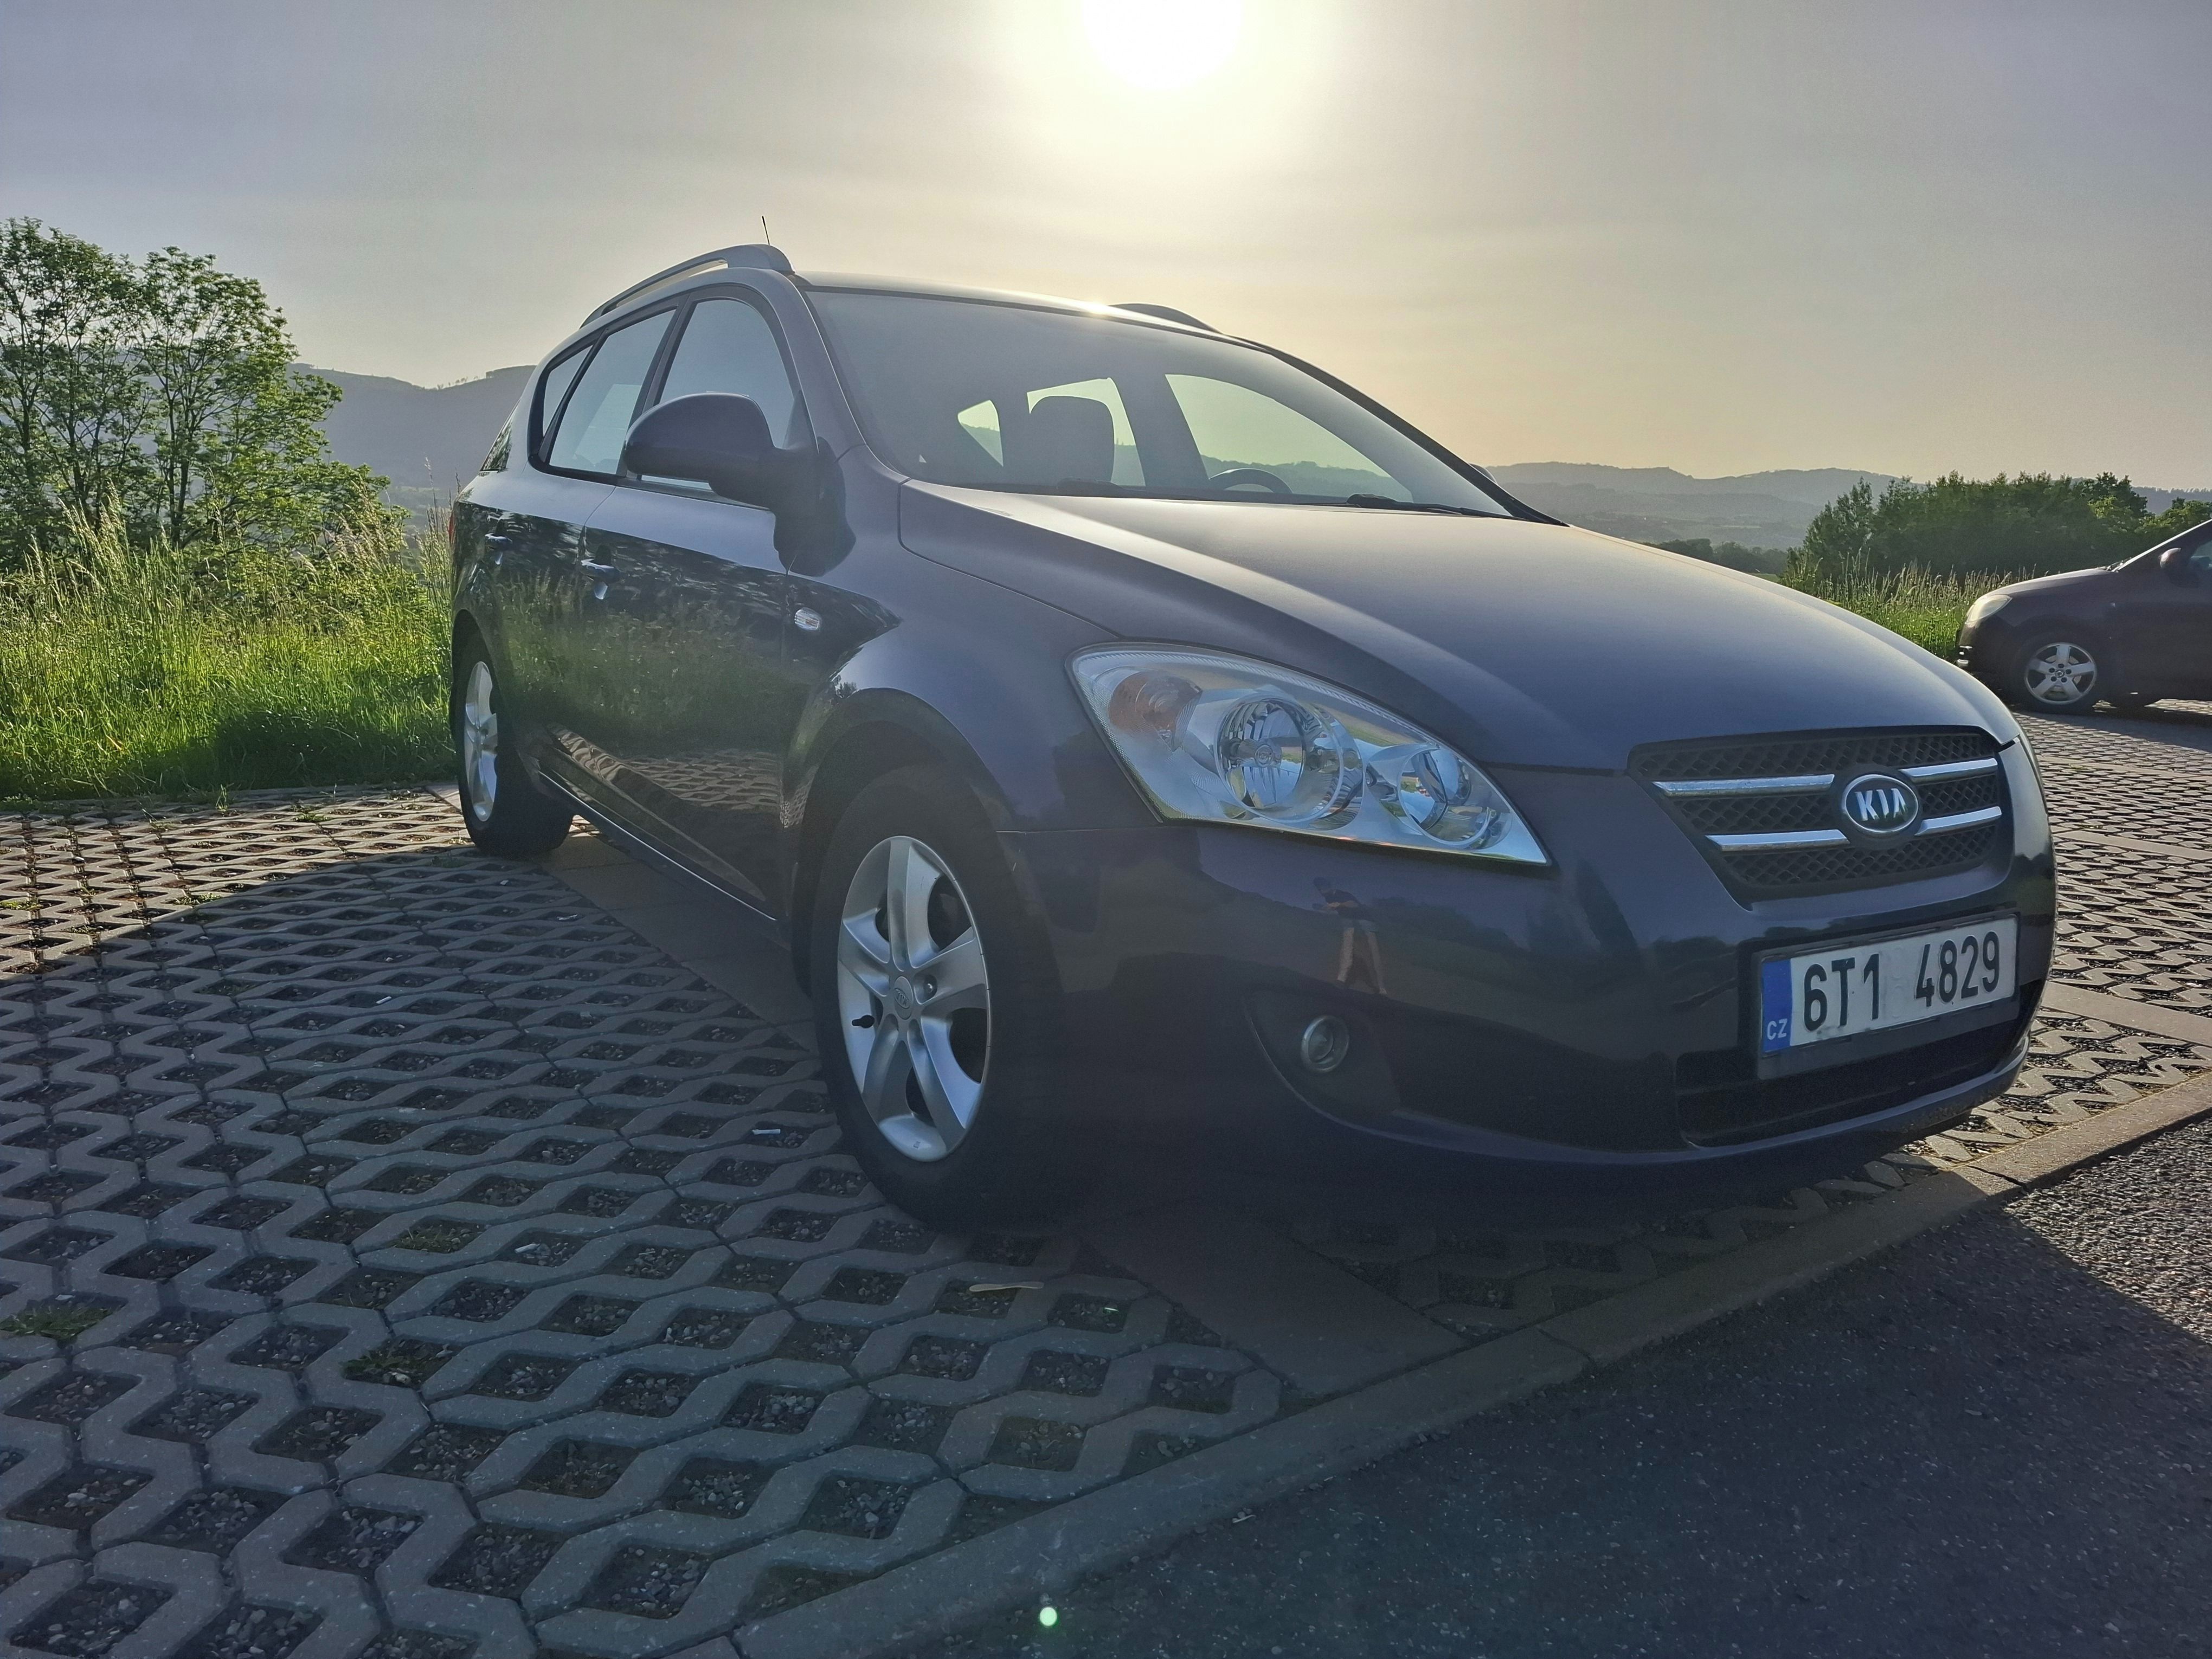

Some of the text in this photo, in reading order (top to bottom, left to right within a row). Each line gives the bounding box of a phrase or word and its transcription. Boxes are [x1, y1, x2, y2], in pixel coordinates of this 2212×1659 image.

[1855, 788, 1908, 821] KIA
[1803, 930, 2000, 1031] 6T1 4829
[1767, 1018, 1787, 1040] CZ
